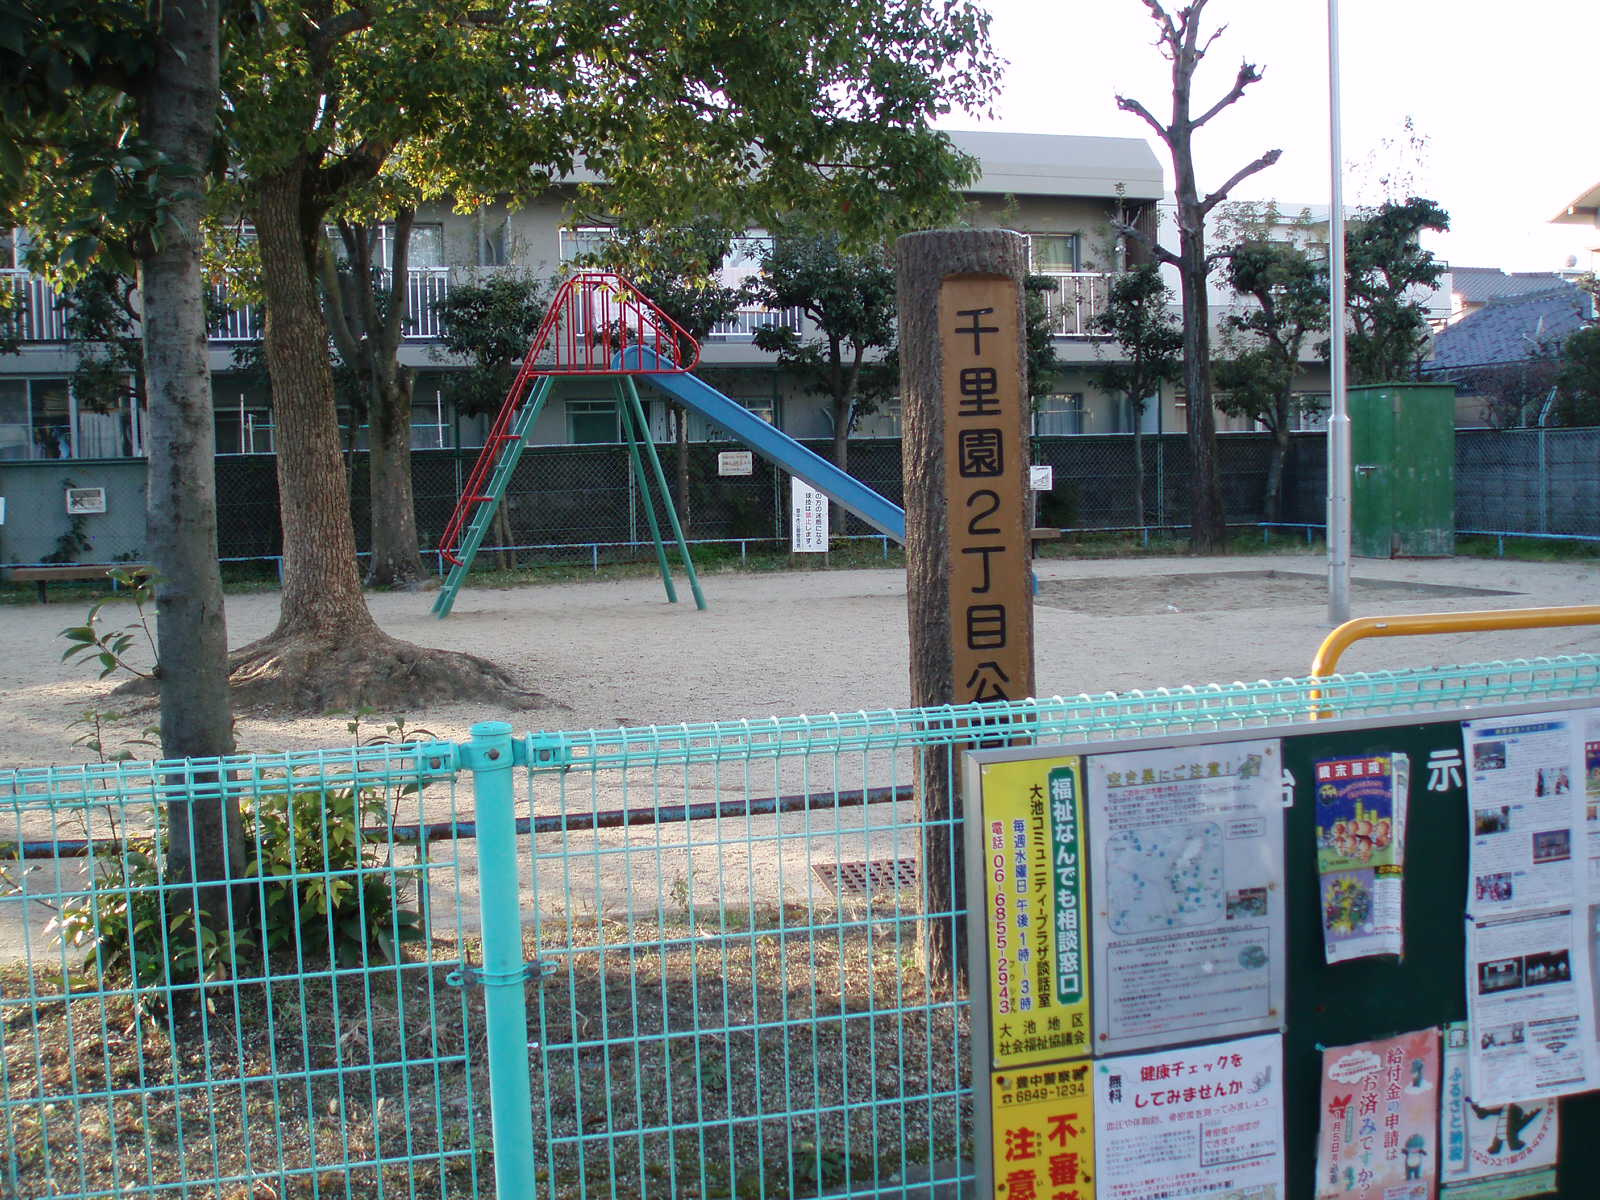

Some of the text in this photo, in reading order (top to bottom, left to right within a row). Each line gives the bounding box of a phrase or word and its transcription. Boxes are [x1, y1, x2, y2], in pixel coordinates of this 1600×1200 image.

[954, 307, 1010, 748] 千里園2丁目公
[1051, 778, 1079, 995] 福祉なんでも相談窓口
[1000, 1030, 1085, 1056] 社会福祉協議会
[1140, 1053, 1243, 1083] 健康チェックを
[1109, 1075, 1122, 1104] 無料
[1135, 1080, 1243, 1108] してみませんか
[1384, 1048, 1404, 1160] 給付金の申請は
